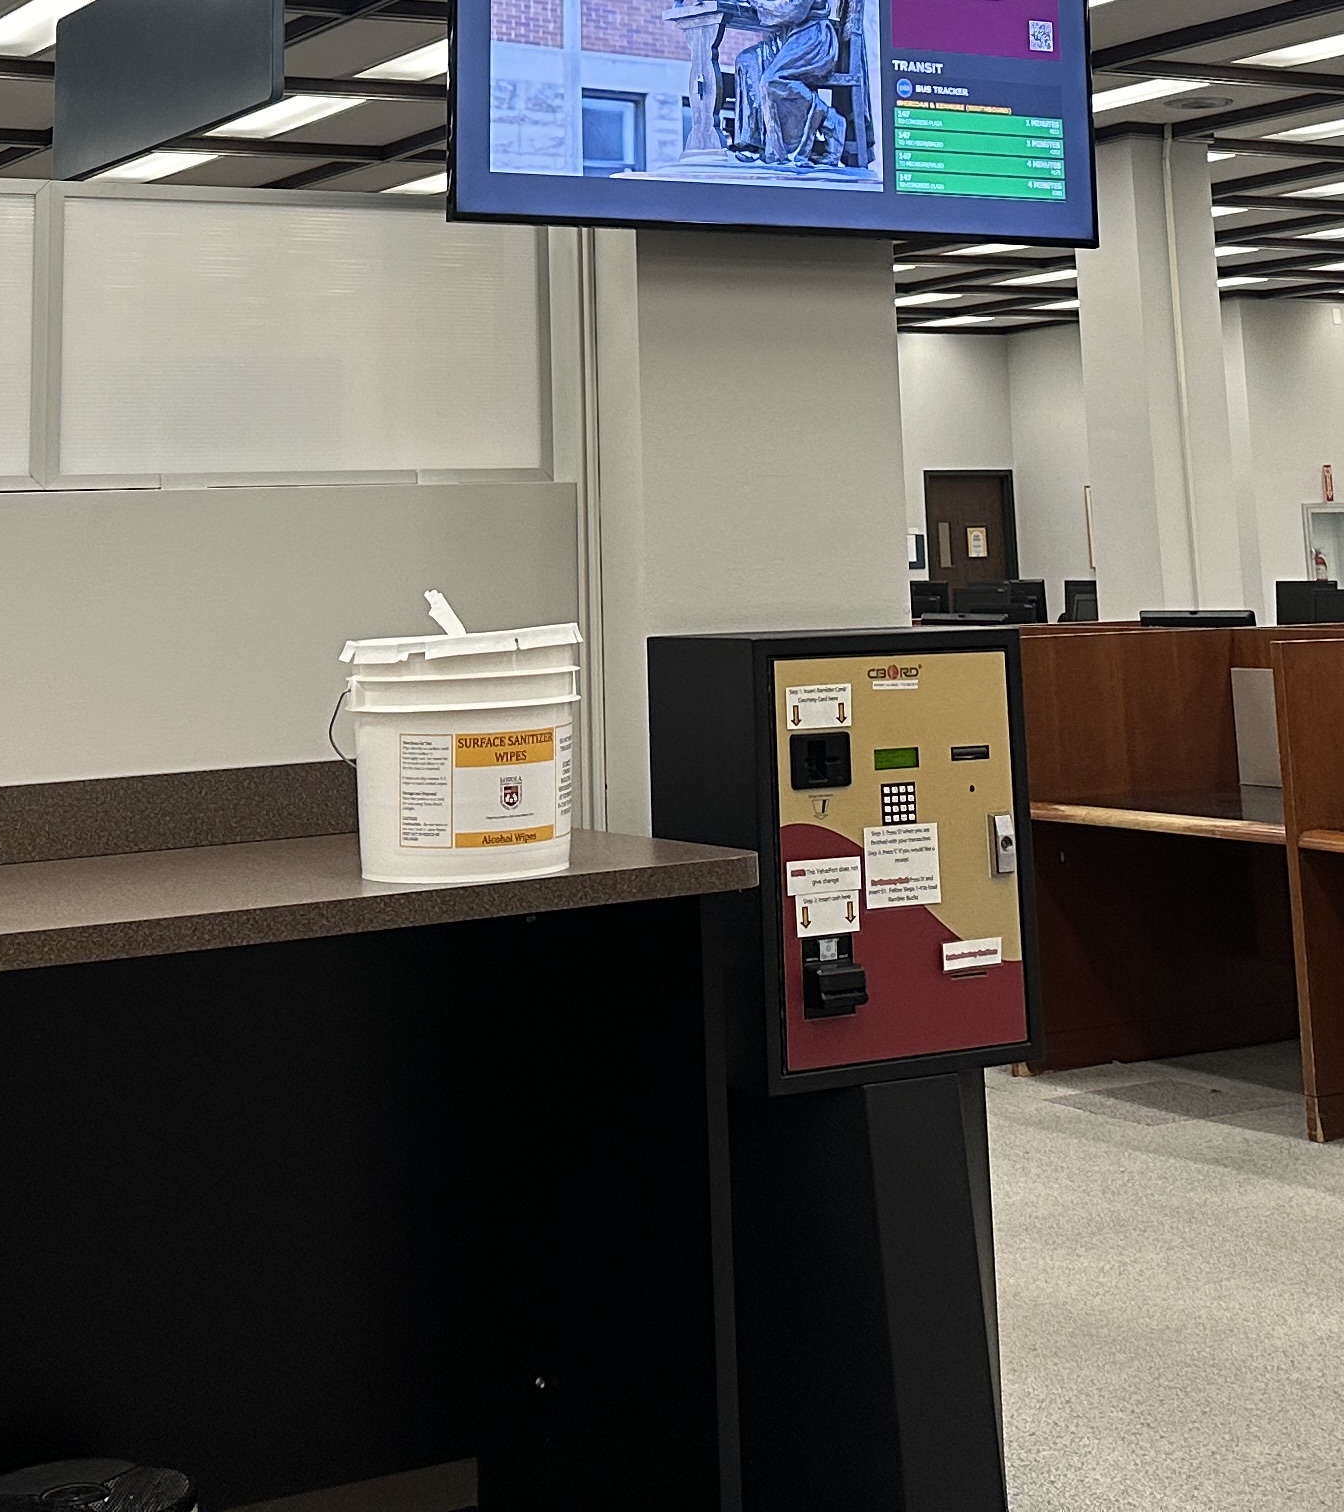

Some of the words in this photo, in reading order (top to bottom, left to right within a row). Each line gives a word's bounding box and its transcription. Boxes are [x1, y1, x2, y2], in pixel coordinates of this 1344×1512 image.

[891, 59, 944, 74] TRANSIT
[915, 84, 932, 94] BUS
[933, 85, 970, 97] TRACKER
[867, 664, 919, 680] CBORD
[457, 736, 507, 749] SURFACE
[507, 732, 553, 747] SANITIZER
[494, 750, 527, 763] WIPES
[481, 833, 513, 845] Alcohol
[514, 832, 537, 843] Wipes
